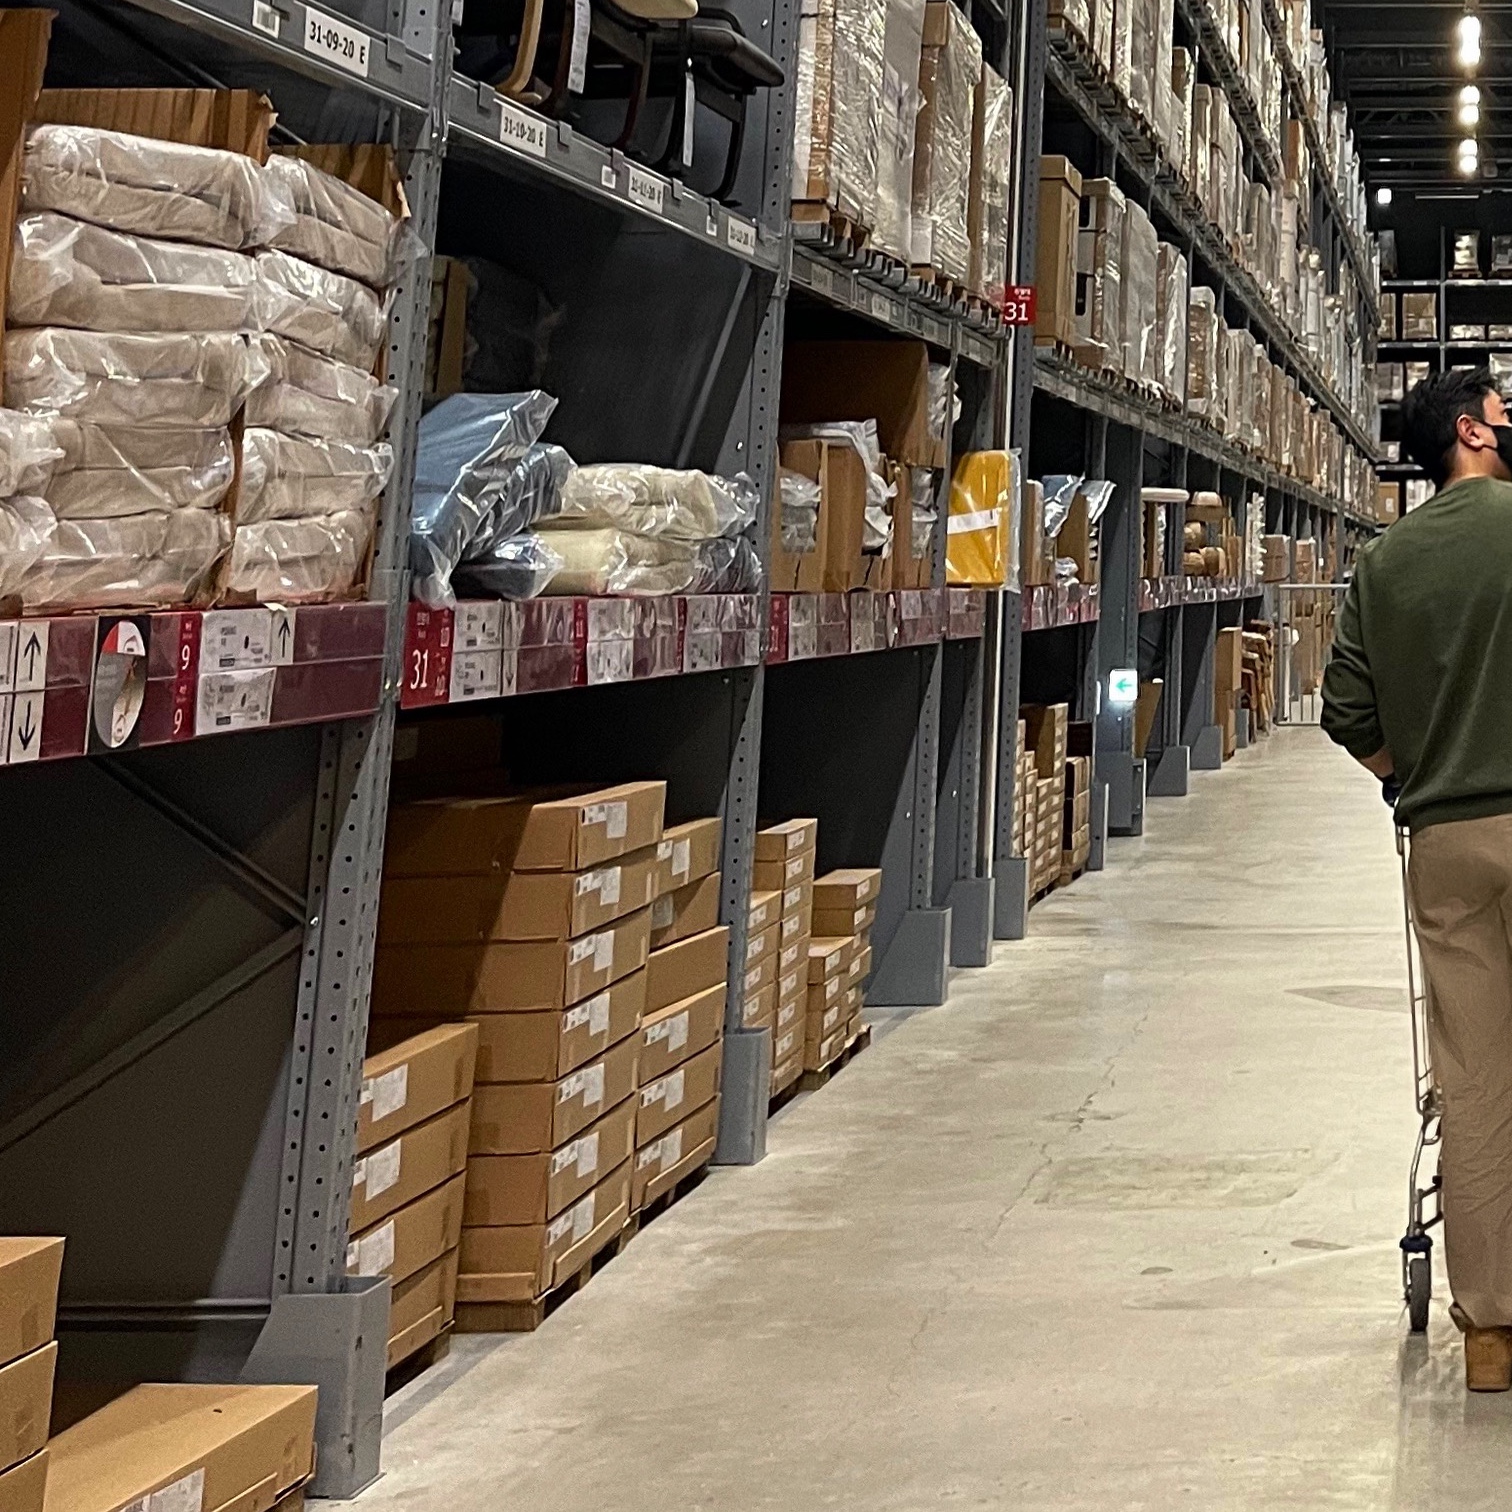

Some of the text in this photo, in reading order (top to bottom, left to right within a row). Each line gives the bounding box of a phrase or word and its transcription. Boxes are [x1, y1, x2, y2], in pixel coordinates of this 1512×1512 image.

[310, 21, 366, 64] 31-09-20 E
[538, 130, 544, 147] E
[1004, 302, 1028, 320] 31
[182, 644, 190, 670] 9
[410, 648, 428, 690] 31
[174, 708, 182, 734] 9
